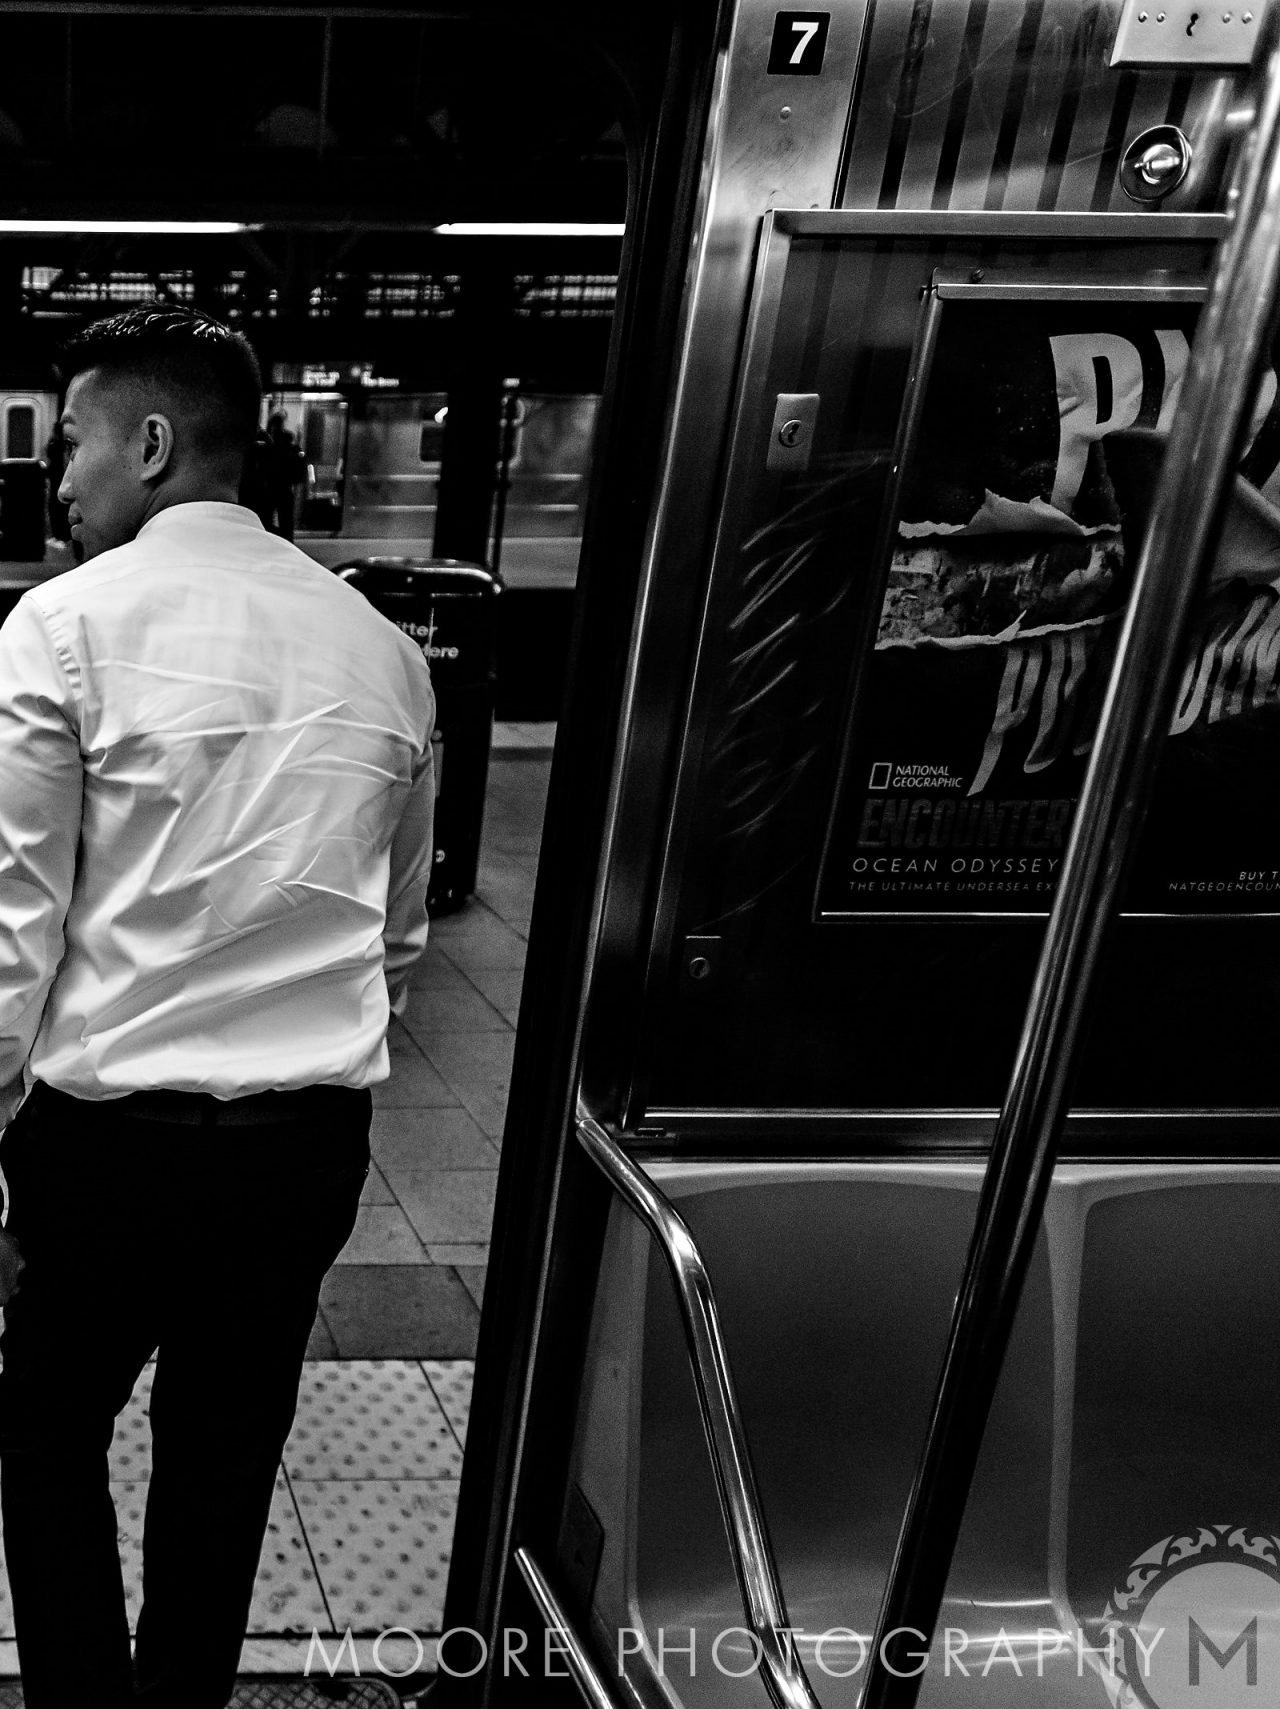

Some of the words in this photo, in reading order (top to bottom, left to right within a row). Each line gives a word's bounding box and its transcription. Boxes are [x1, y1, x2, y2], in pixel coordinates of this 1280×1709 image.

[788, 21, 820, 65] 7
[895, 765, 950, 777] NATIONAL
[892, 777, 964, 788] GEOGRAPHIC
[856, 798, 1071, 848] ENCOUNTER
[852, 858, 938, 873] OCEAN
[951, 858, 1060, 873] ODYSSEY
[1239, 871, 1266, 881] BUY
[849, 881, 875, 891] THE
[881, 881, 951, 891] ULTIMATE
[956, 881, 1030, 891] UNDERSEA
